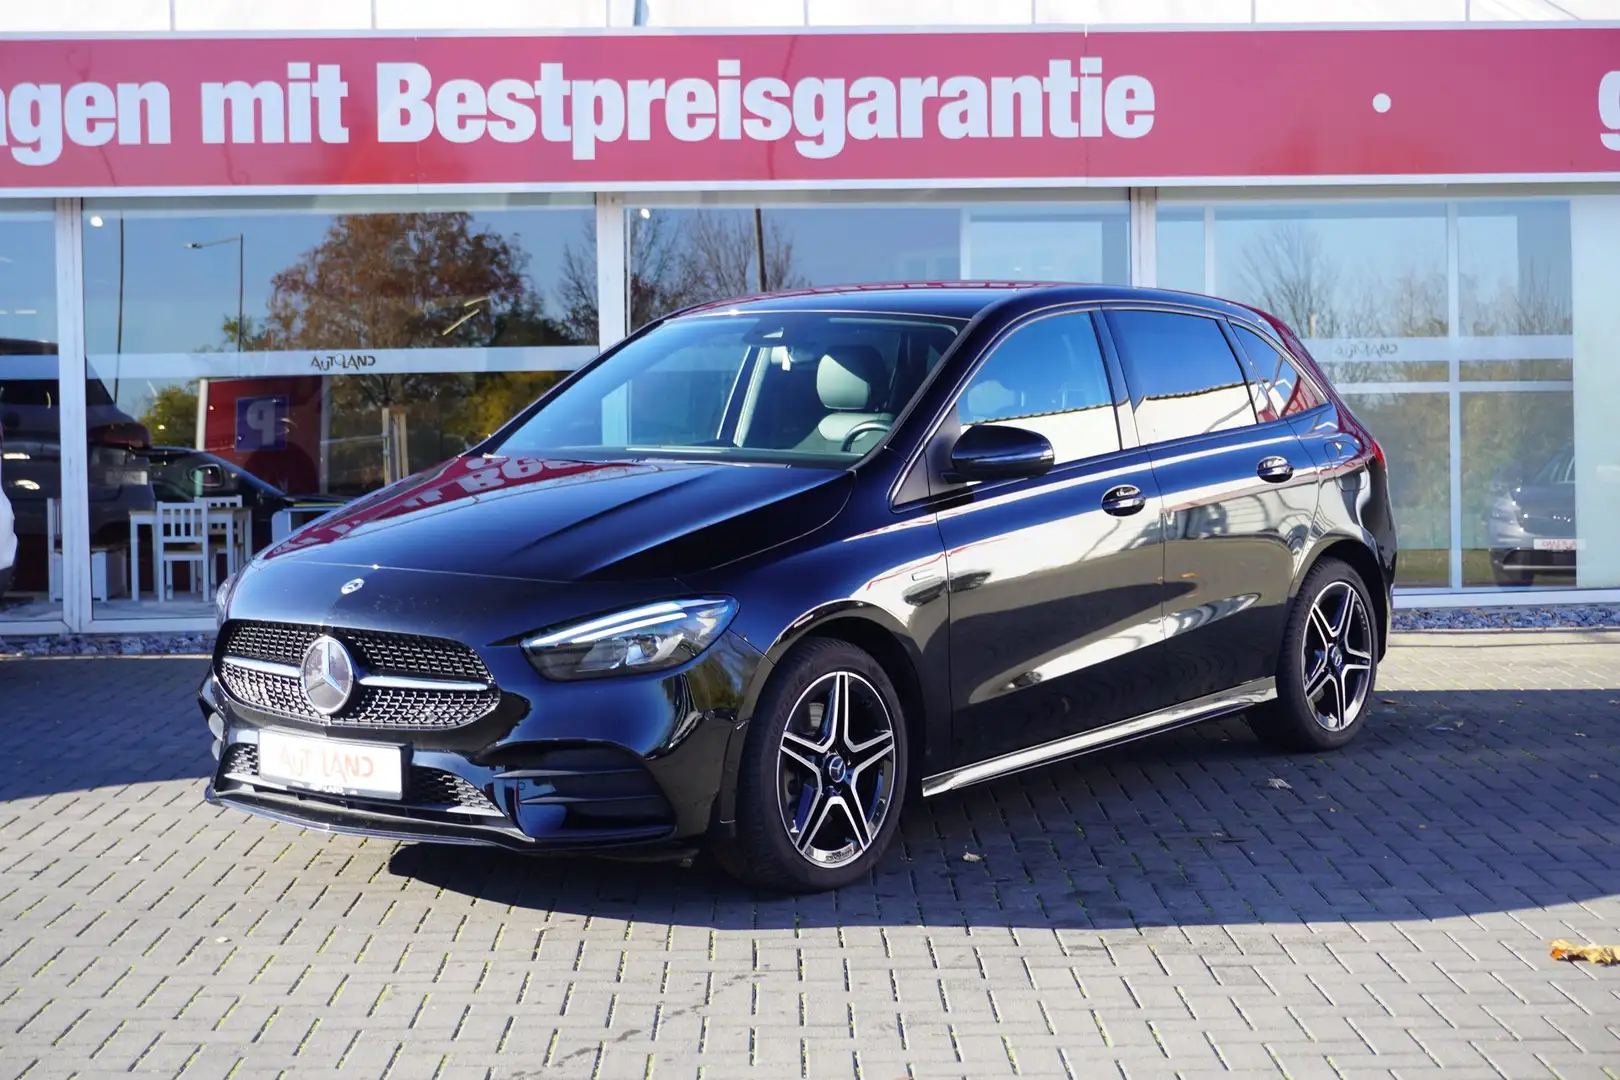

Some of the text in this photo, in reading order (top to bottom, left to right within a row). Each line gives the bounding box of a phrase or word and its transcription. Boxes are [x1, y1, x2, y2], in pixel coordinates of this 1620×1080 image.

[0, 56, 1156, 166] gen mit Bestpreisgarantie
[280, 743, 375, 784] AUTLAND
